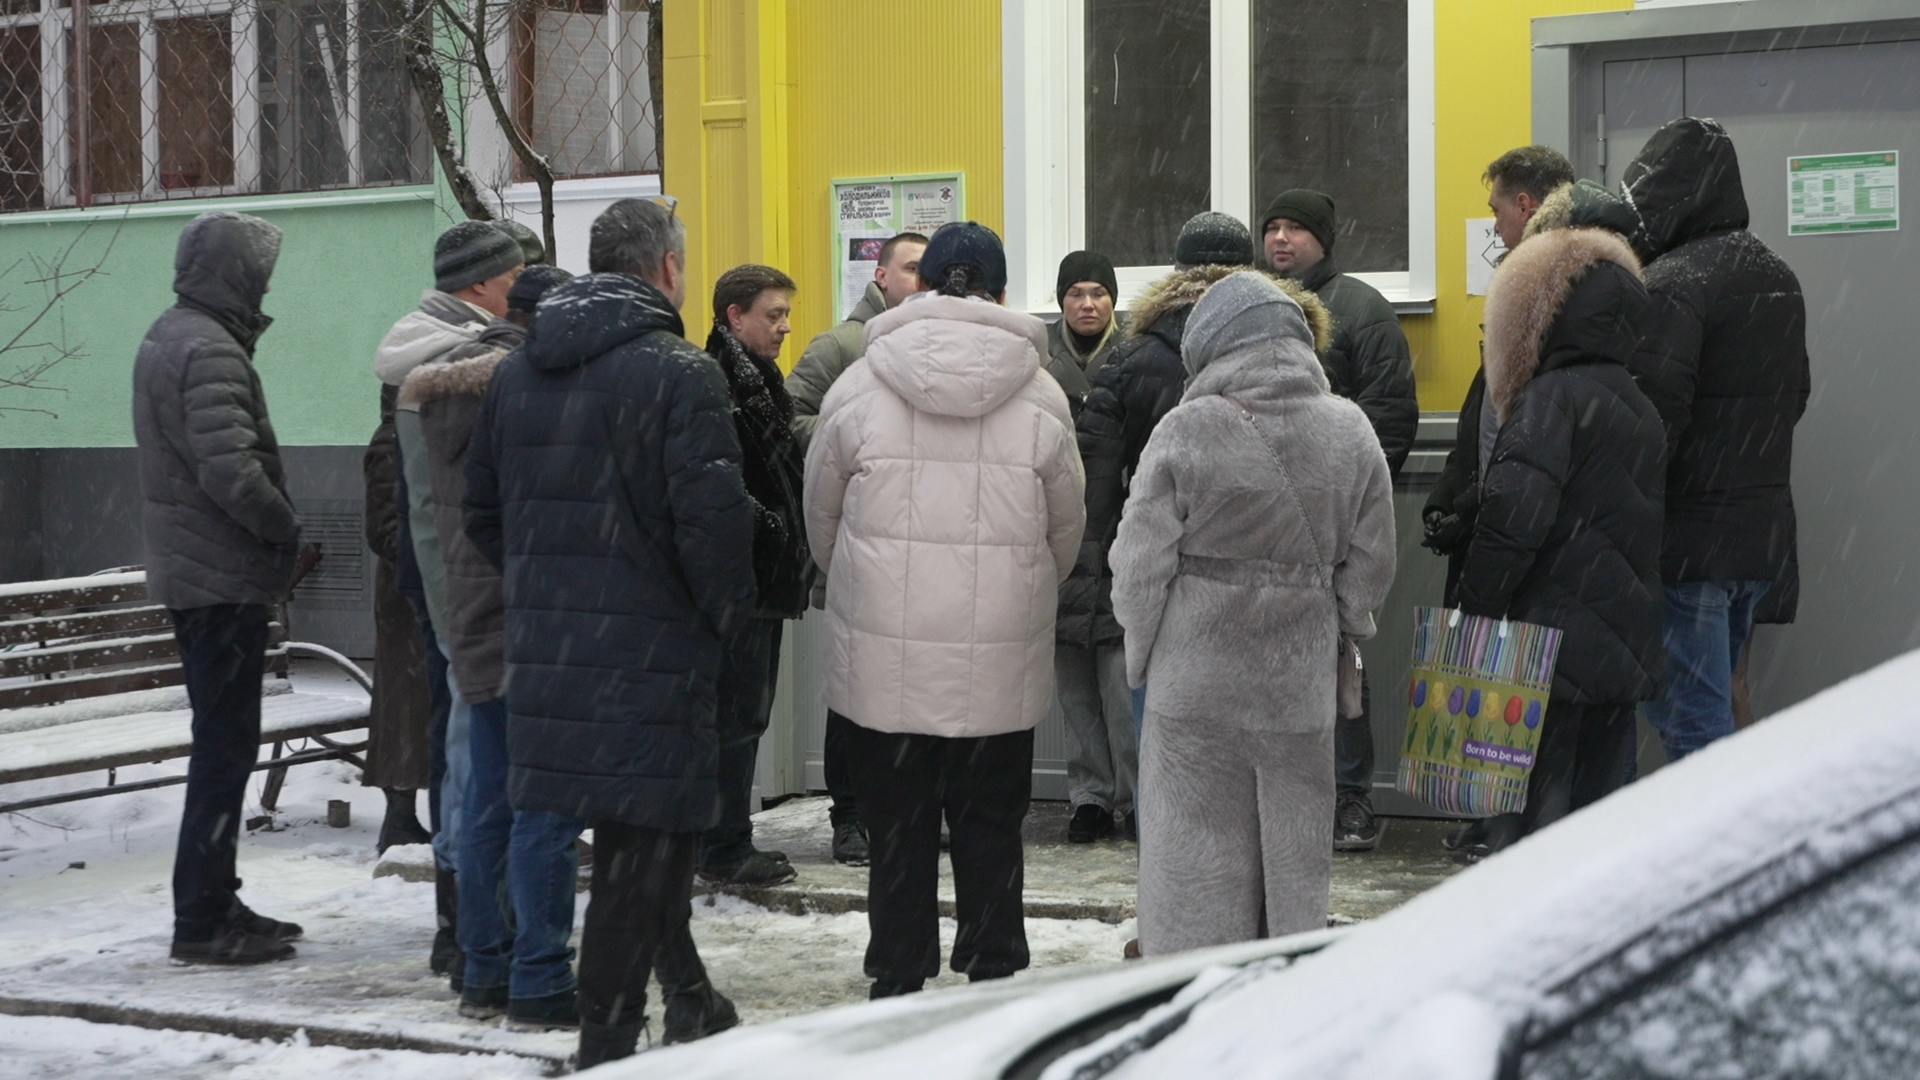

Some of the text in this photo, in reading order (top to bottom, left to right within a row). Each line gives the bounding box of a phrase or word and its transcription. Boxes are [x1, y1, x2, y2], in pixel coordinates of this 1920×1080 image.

[840, 190, 891, 201] ХОЛОДИЛЬНИКОВ
[840, 211, 874, 220] СТИРАЛЬНЫХ
[1465, 743, 1532, 765] Born to be wild
